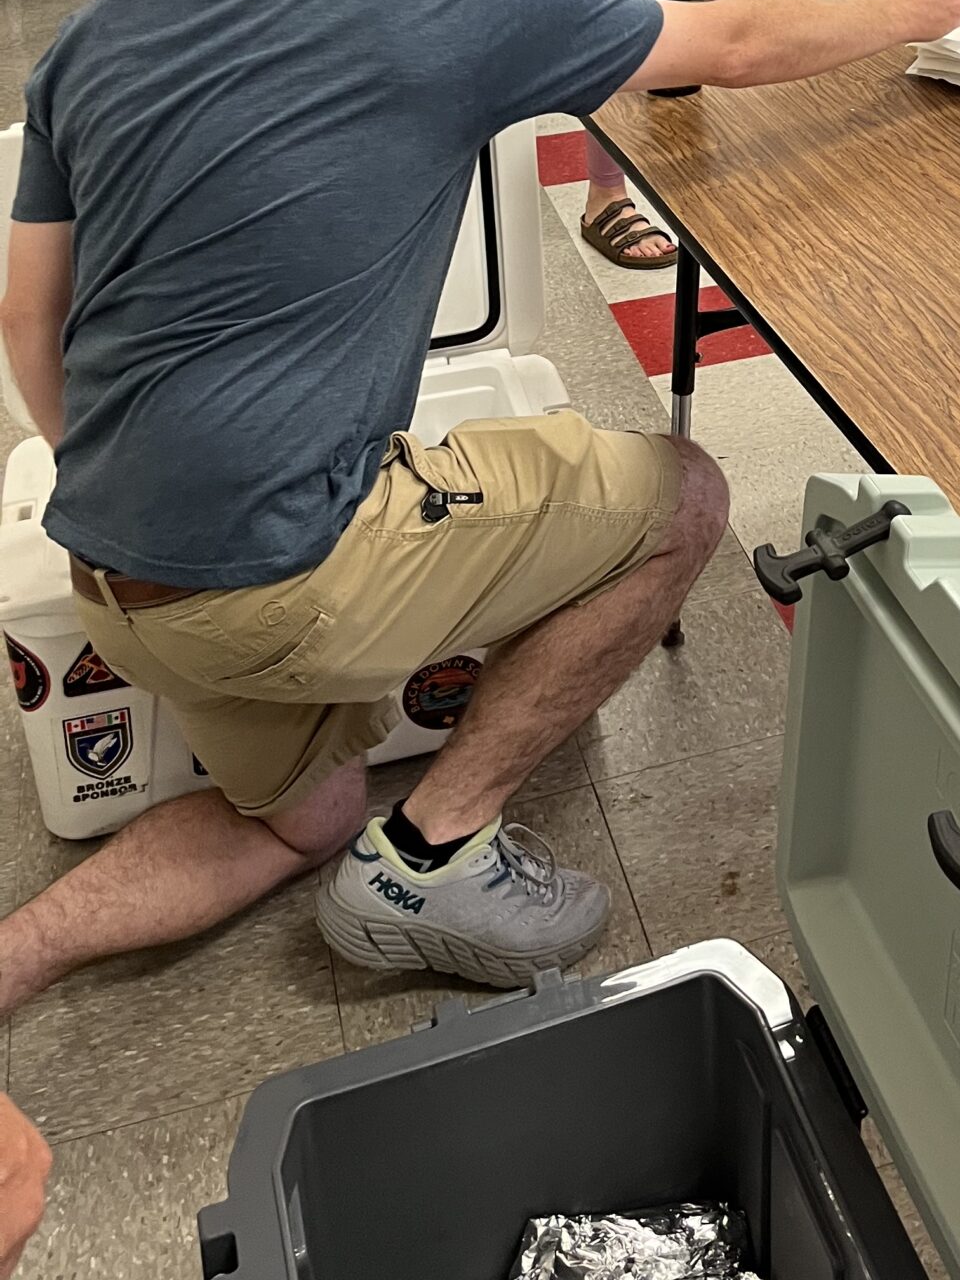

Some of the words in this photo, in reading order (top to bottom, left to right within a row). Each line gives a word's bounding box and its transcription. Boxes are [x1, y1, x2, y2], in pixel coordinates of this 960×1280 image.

[408, 681, 420, 713] BACK
[420, 660, 464, 679] DOWN
[73, 783, 137, 803] SPONSOR
[76, 775, 132, 794] BRONZE
[368, 871, 426, 914] HOKA
